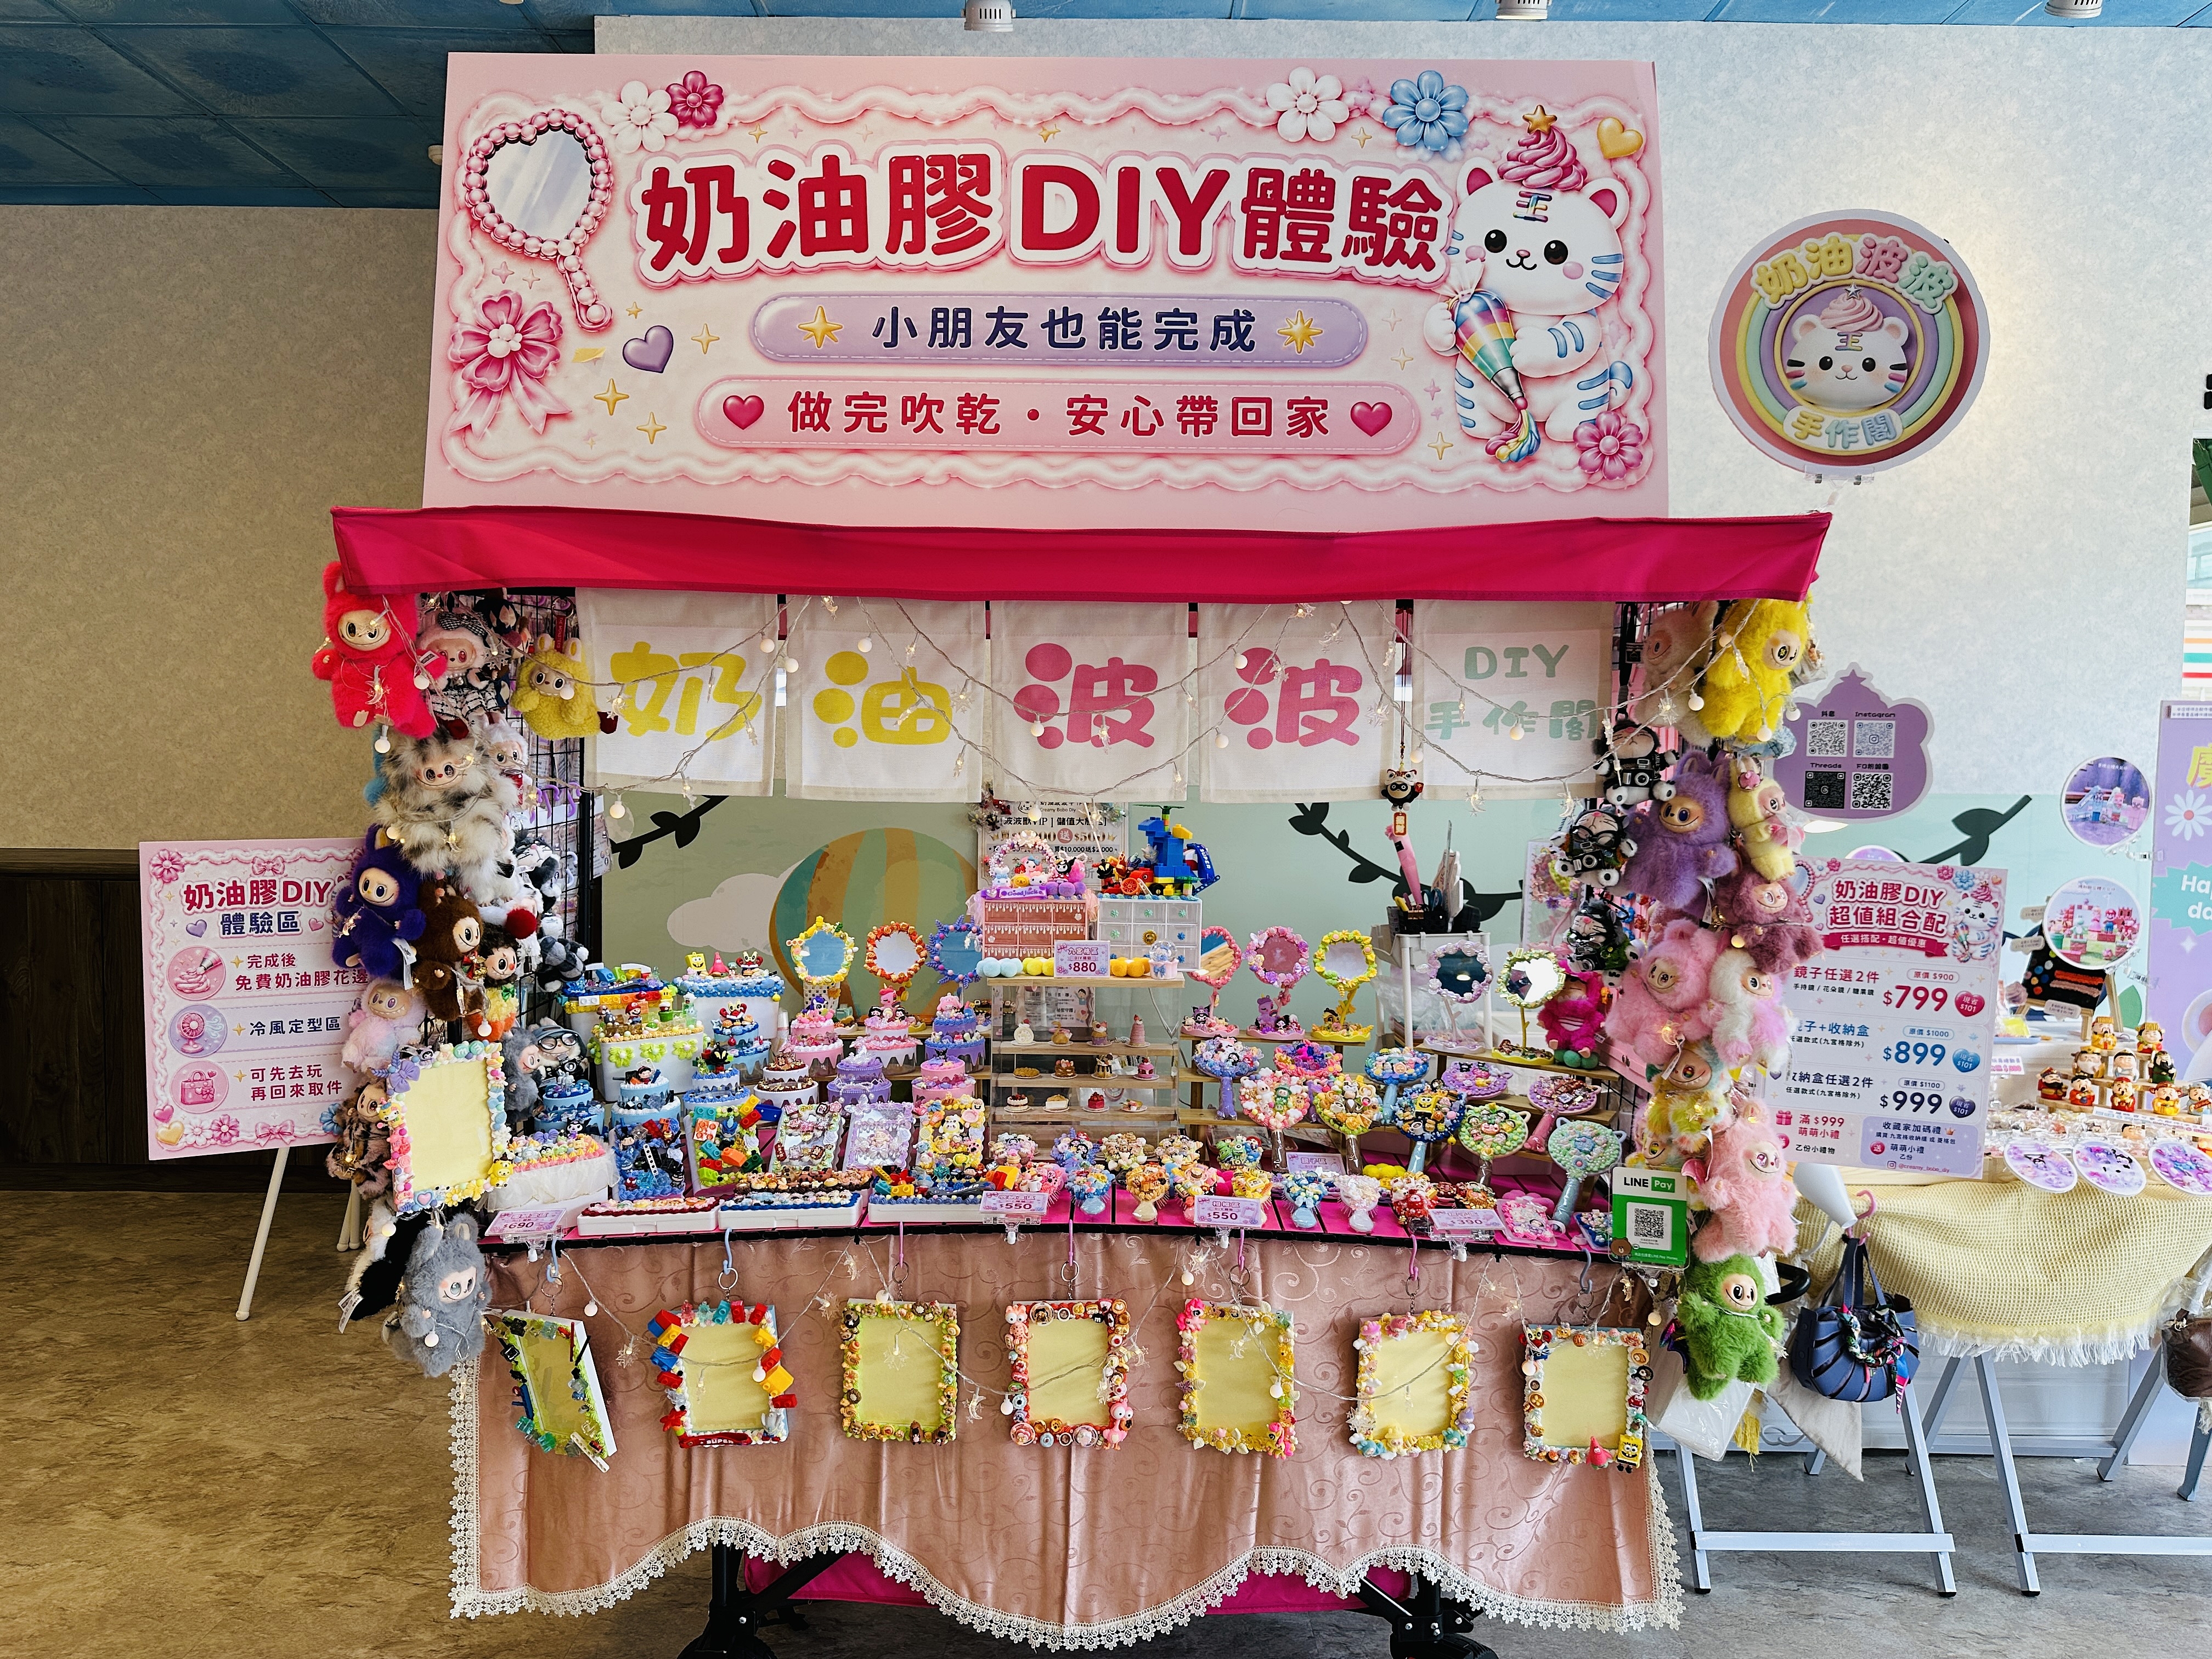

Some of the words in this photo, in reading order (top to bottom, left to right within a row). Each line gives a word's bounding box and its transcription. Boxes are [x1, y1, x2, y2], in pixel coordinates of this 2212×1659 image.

[641, 153, 1440, 272] 奶油膠DIY體驗
[1756, 236, 1954, 309] 奶油波波
[871, 306, 1256, 353] 小朋友也能完成
[1791, 410, 1897, 449] 手作閣
[1464, 644, 1570, 680] DIY
[184, 879, 331, 911] 奶油膠DIY
[1835, 880, 1944, 906] 奶油膠DIY
[2181, 874, 2212, 900] Ha
[220, 911, 301, 936] 體驗區
[1829, 905, 1948, 934] 超值組合配
[247, 953, 297, 969] 完成後
[1068, 962, 1097, 972] $880
[235, 970, 369, 991] 免費奶油膠花邊
[1932, 973, 1954, 981] $900
[1882, 985, 1949, 1012] $799
[1960, 1004, 1977, 1013] $101
[250, 1016, 341, 1036] 冷風定型區
[1797, 1019, 1870, 1037] 子+收納盒
[1926, 1030, 1950, 1038] $1000
[1882, 1041, 1946, 1066] $899
[250, 1064, 324, 1082] 可先去玩
[1957, 1060, 1973, 1070] $101
[250, 1080, 343, 1102] 再回來取件
[1920, 1081, 1940, 1089] $1100
[1879, 1090, 1943, 1115] $999
[1953, 1107, 1968, 1116] $101
[1813, 1115, 1845, 1127] $999
[1798, 1126, 1840, 1140] 萌萌小禮
[1623, 1177, 1649, 1188] LINE
[1654, 1180, 1673, 1190] Pay
[1207, 1211, 1238, 1220] $550
